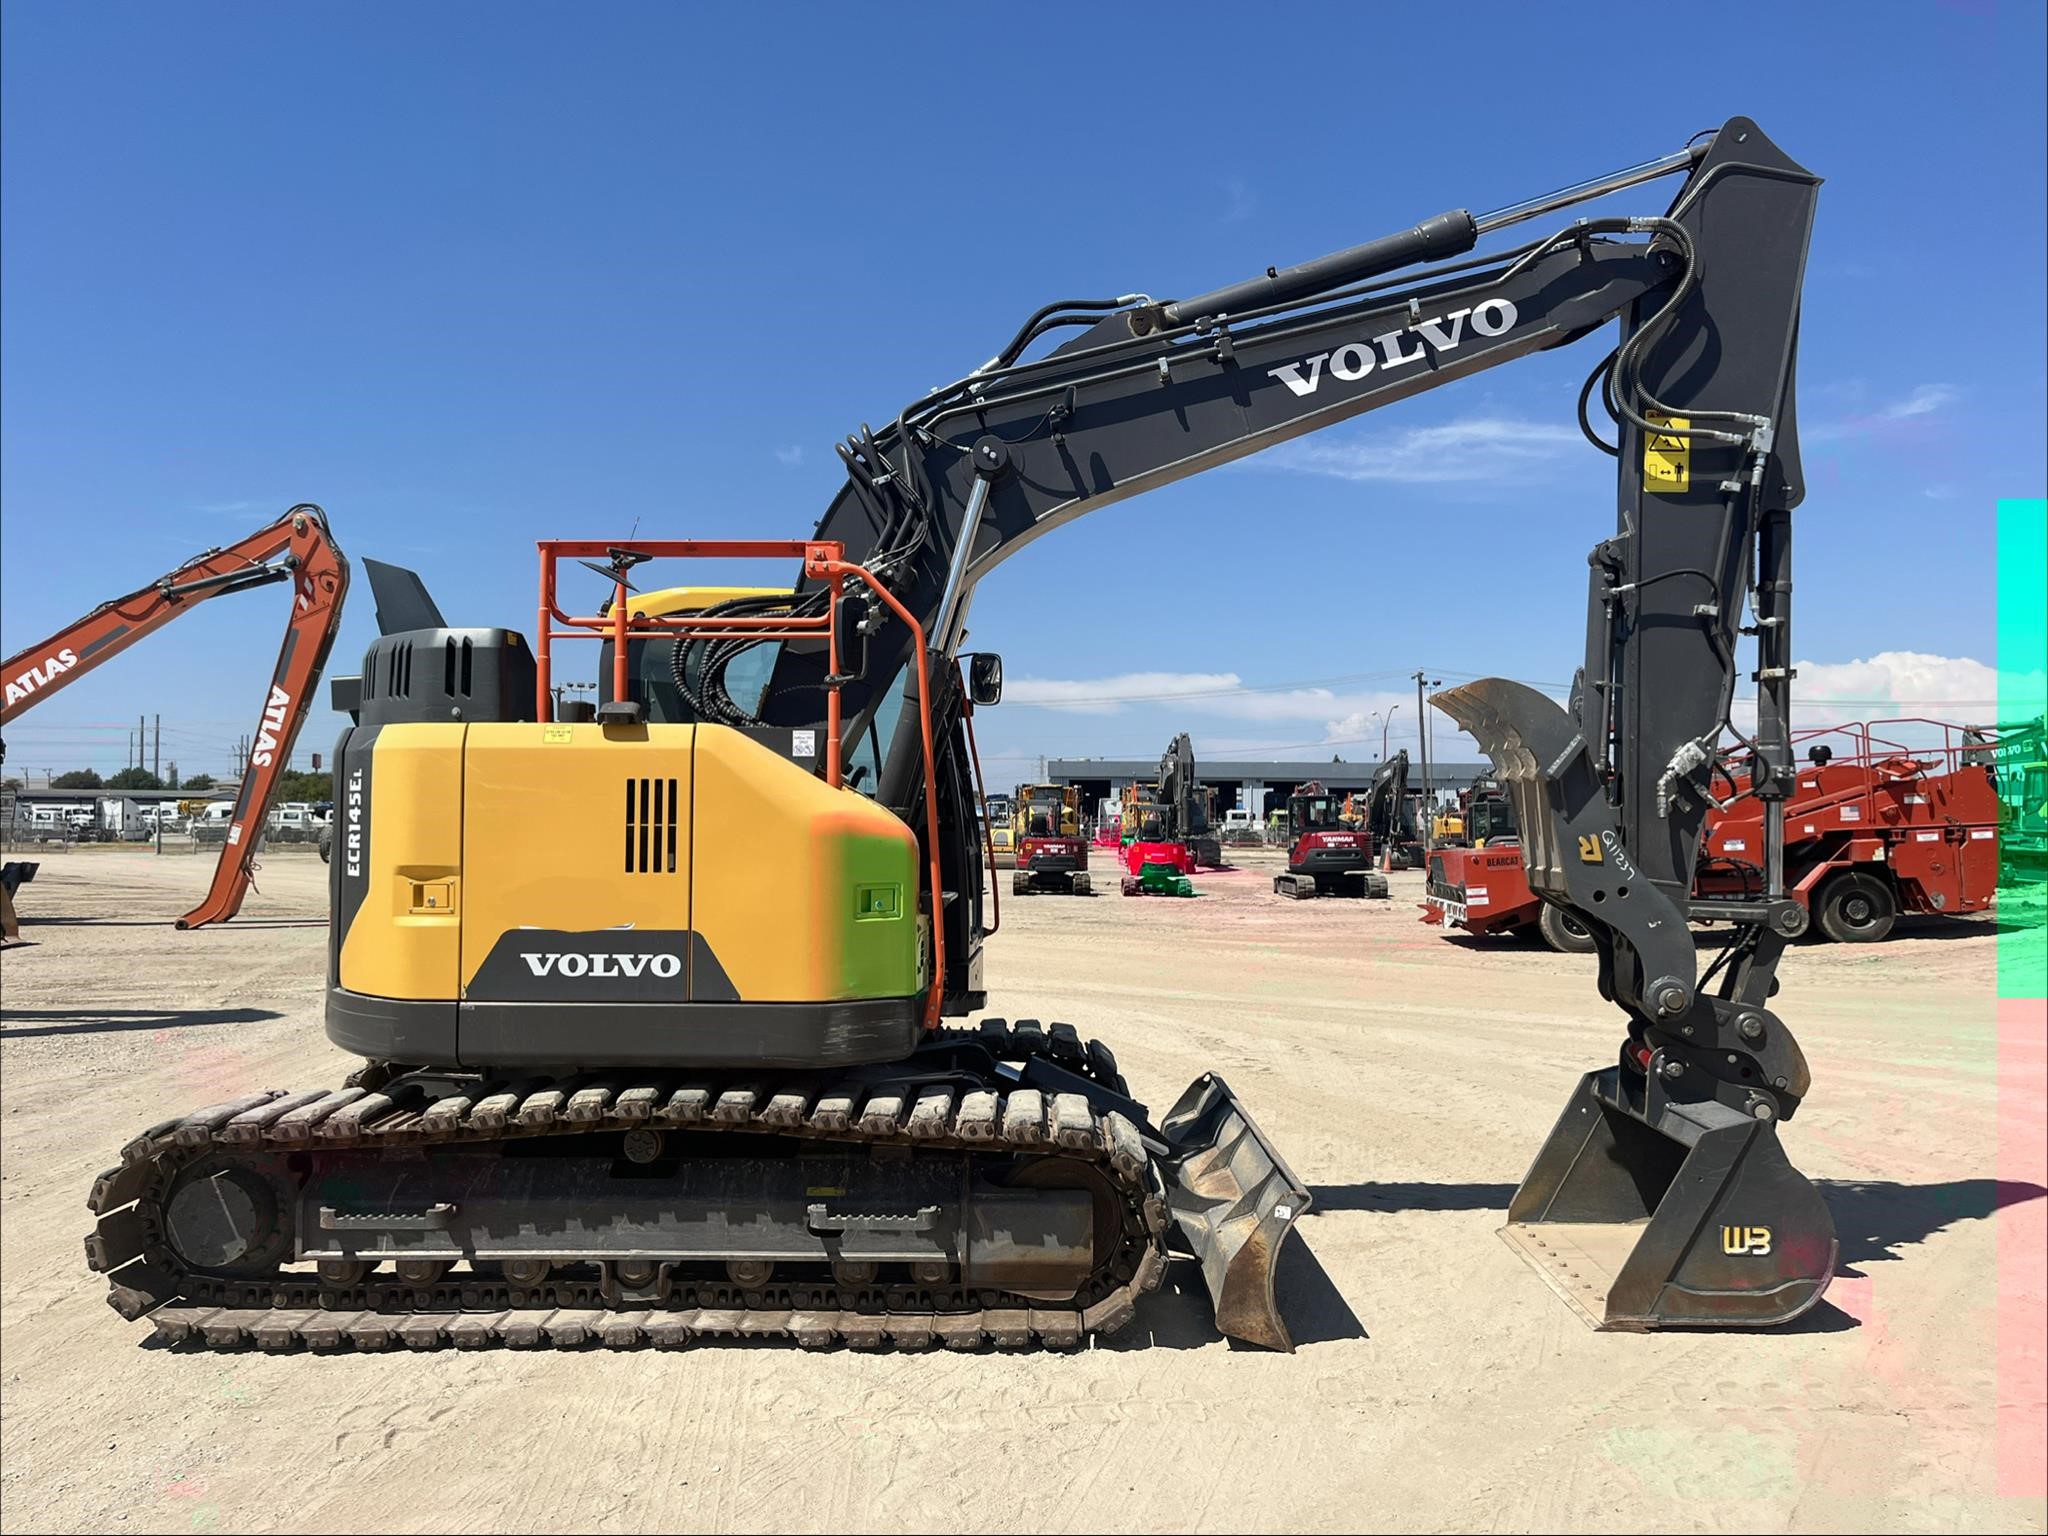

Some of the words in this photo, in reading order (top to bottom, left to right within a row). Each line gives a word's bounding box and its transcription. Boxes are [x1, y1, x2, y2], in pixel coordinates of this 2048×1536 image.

[1267, 298, 1518, 397] VOLVO
[5, 648, 78, 706] ATLAS
[252, 684, 290, 768] ATLAS
[1486, 856, 1519, 867] BEARCAT
[520, 953, 681, 978] VOLVO
